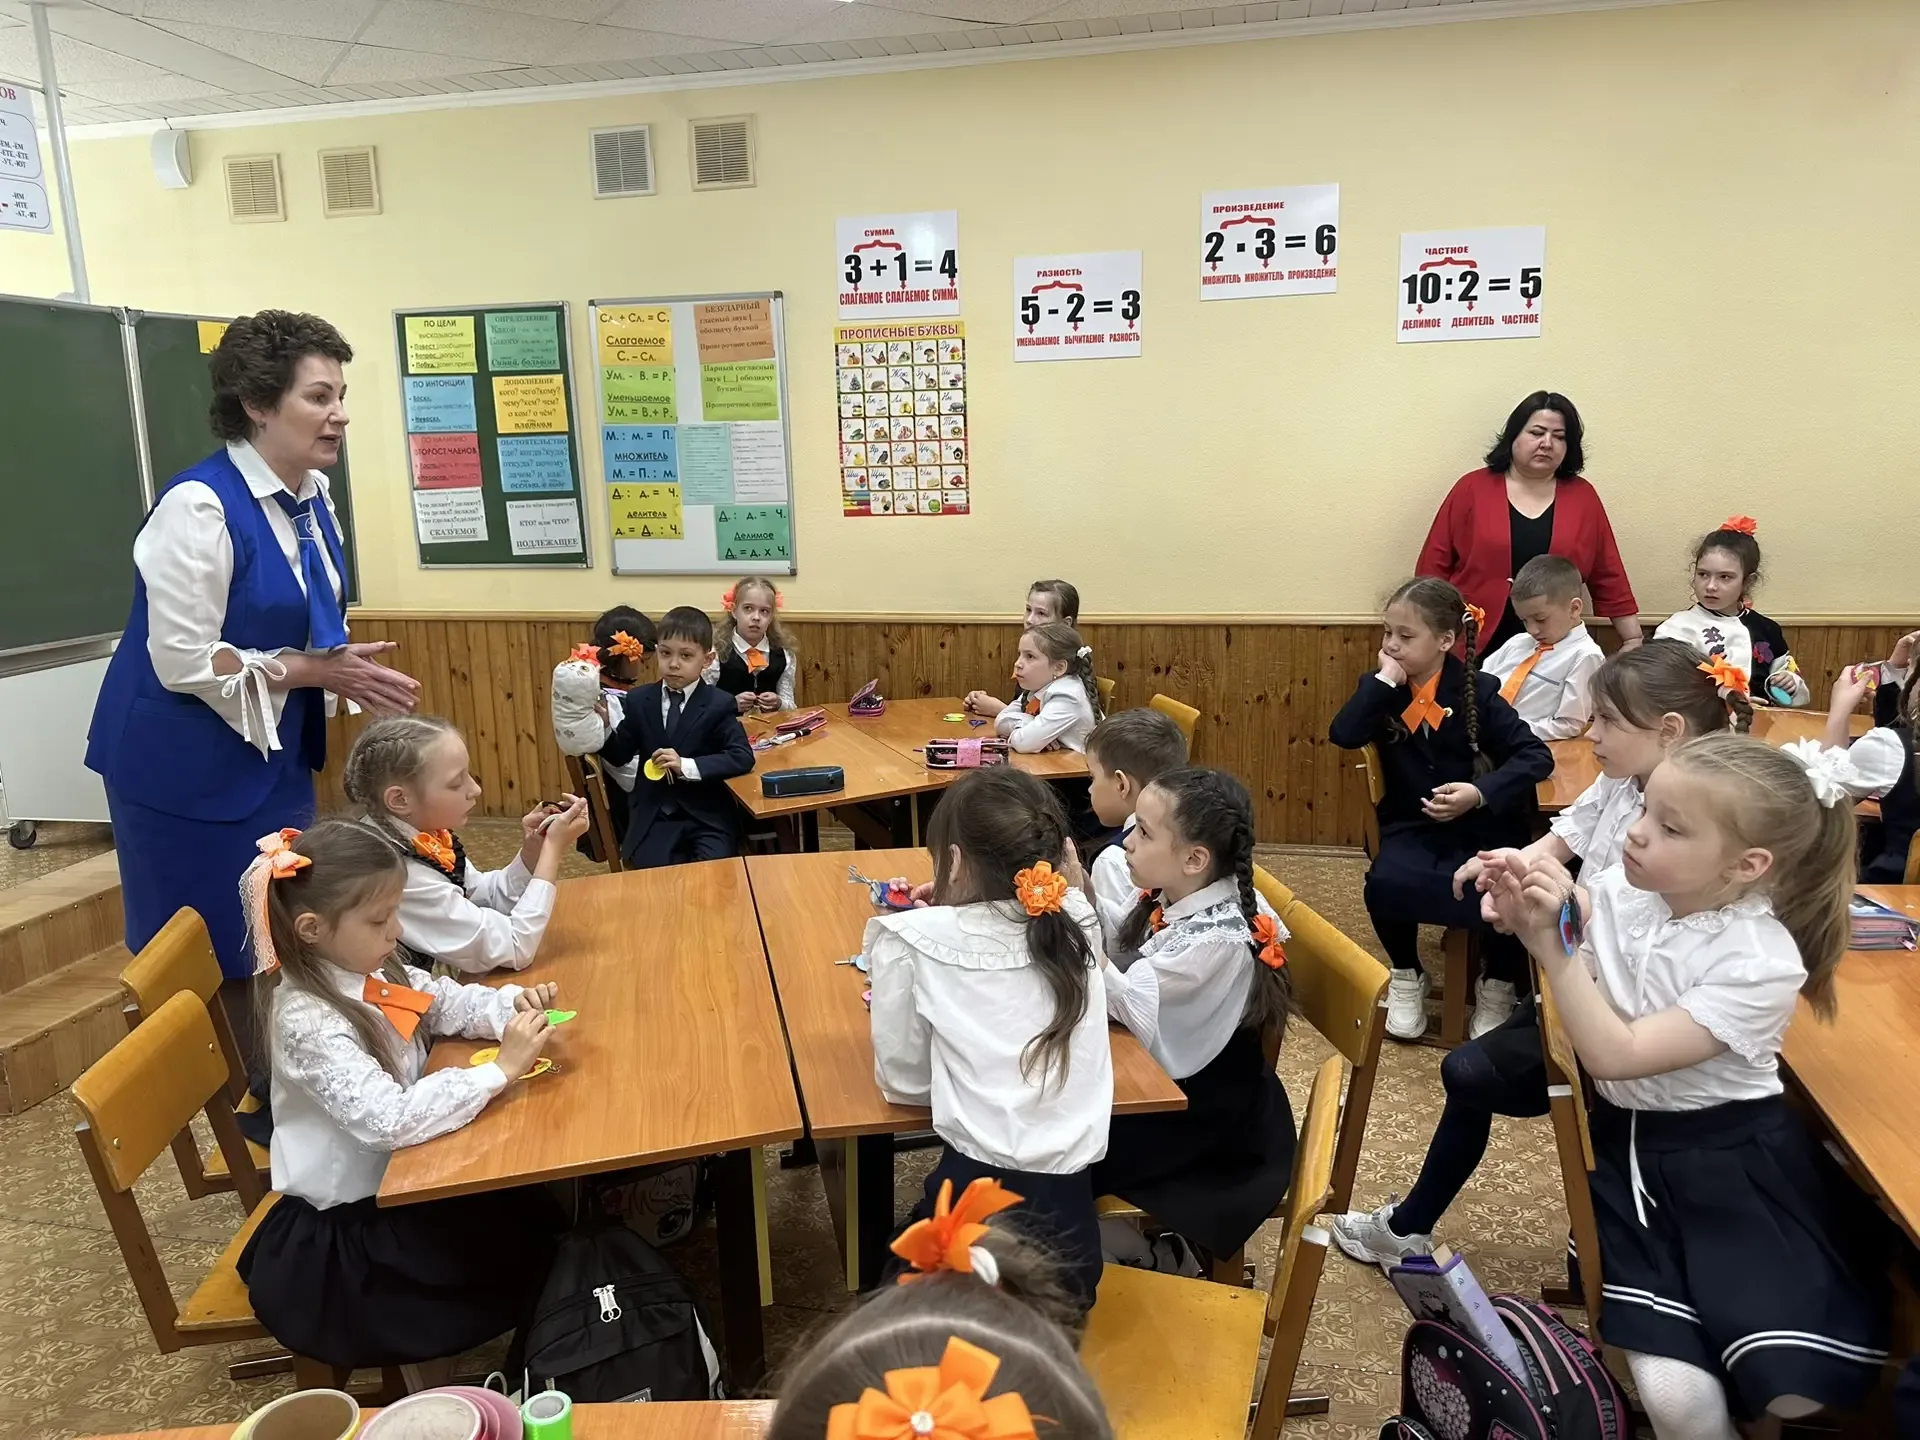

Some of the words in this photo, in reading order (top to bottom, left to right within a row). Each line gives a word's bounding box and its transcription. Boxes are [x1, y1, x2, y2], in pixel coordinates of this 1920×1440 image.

[1213, 202, 1284, 214] ПРОИЗВЕДЕНИЕ
[864, 229, 895, 237] СУММА
[1205, 232, 1224, 262] 2
[1255, 228, 1275, 259] 3
[1315, 224, 1336, 255] 6
[1425, 246, 1469, 255] ЧАСТНОЕ
[845, 254, 862, 284] 3
[894, 252, 906, 281] 1
[940, 250, 957, 279] 4
[1037, 269, 1082, 277] РАЗНОСТЬ
[1202, 274, 1241, 285] МНОЖИТЕЛЬ
[1245, 272, 1284, 282] МНОЖИТЕЛЬ
[1288, 268, 1336, 280] ПРОИЗВЕДЕНИЕ
[1520, 268, 1541, 299] 5
[840, 292, 883, 305] СЛАГАЕМОЕ
[886, 290, 930, 304] СЛАГАЕМОЕ
[933, 288, 958, 301] СУММА
[705, 301, 760, 313] БЕЗУДАРНЫЙ
[1021, 295, 1040, 325] 5
[1067, 293, 1085, 323] 2
[1122, 290, 1140, 320] 3
[628, 313, 644, 322] Сл.
[657, 312, 669, 322] С.
[700, 316, 730, 324] гласный
[1402, 318, 1441, 330] ДЕЛИМОЕ
[1451, 316, 1494, 328] ДЕЛИТЕЛЬ
[1502, 314, 1539, 324] ЧАСТНОЕ
[840, 327, 914, 340] ПРОПИСНЫЕ
[918, 324, 958, 336] БУКВЫ
[606, 336, 665, 345] Слагаемое
[1017, 336, 1060, 347] УМЕНЬШАЕМОЕ
[1065, 334, 1104, 344] ВЫЧИТАЕМОЕ
[1109, 332, 1140, 342] РАЗНОСТЬ
[617, 351, 629, 361] С.
[640, 352, 656, 361] Сл.
[735, 364, 775, 372] согласный
[606, 370, 625, 380] Ум.
[640, 371, 648, 380] В.
[662, 372, 671, 381] Р.
[499, 388, 518, 396] кого?
[607, 393, 671, 402] Уменьшаемое
[607, 406, 628, 417] Ум.
[663, 408, 672, 418] Р.
[606, 431, 619, 440] М.
[663, 430, 673, 440] П.
[615, 452, 668, 460] МНОЖИТЕЛЬ
[504, 459, 533, 468] откуда?
[613, 469, 625, 479] М.
[639, 468, 649, 478] П.
[668, 488, 678, 497] Ч.
[776, 509, 786, 518] Ч.
[430, 528, 478, 536] СКАЗУЕМОЕ
[670, 524, 680, 534] Ч.
[734, 532, 774, 540] Делимое
[517, 538, 578, 548] ПОДЛЕЖАЩЕЕ
[778, 546, 788, 556] Ч.
[1547, 1323, 1595, 1369] ACROSS
